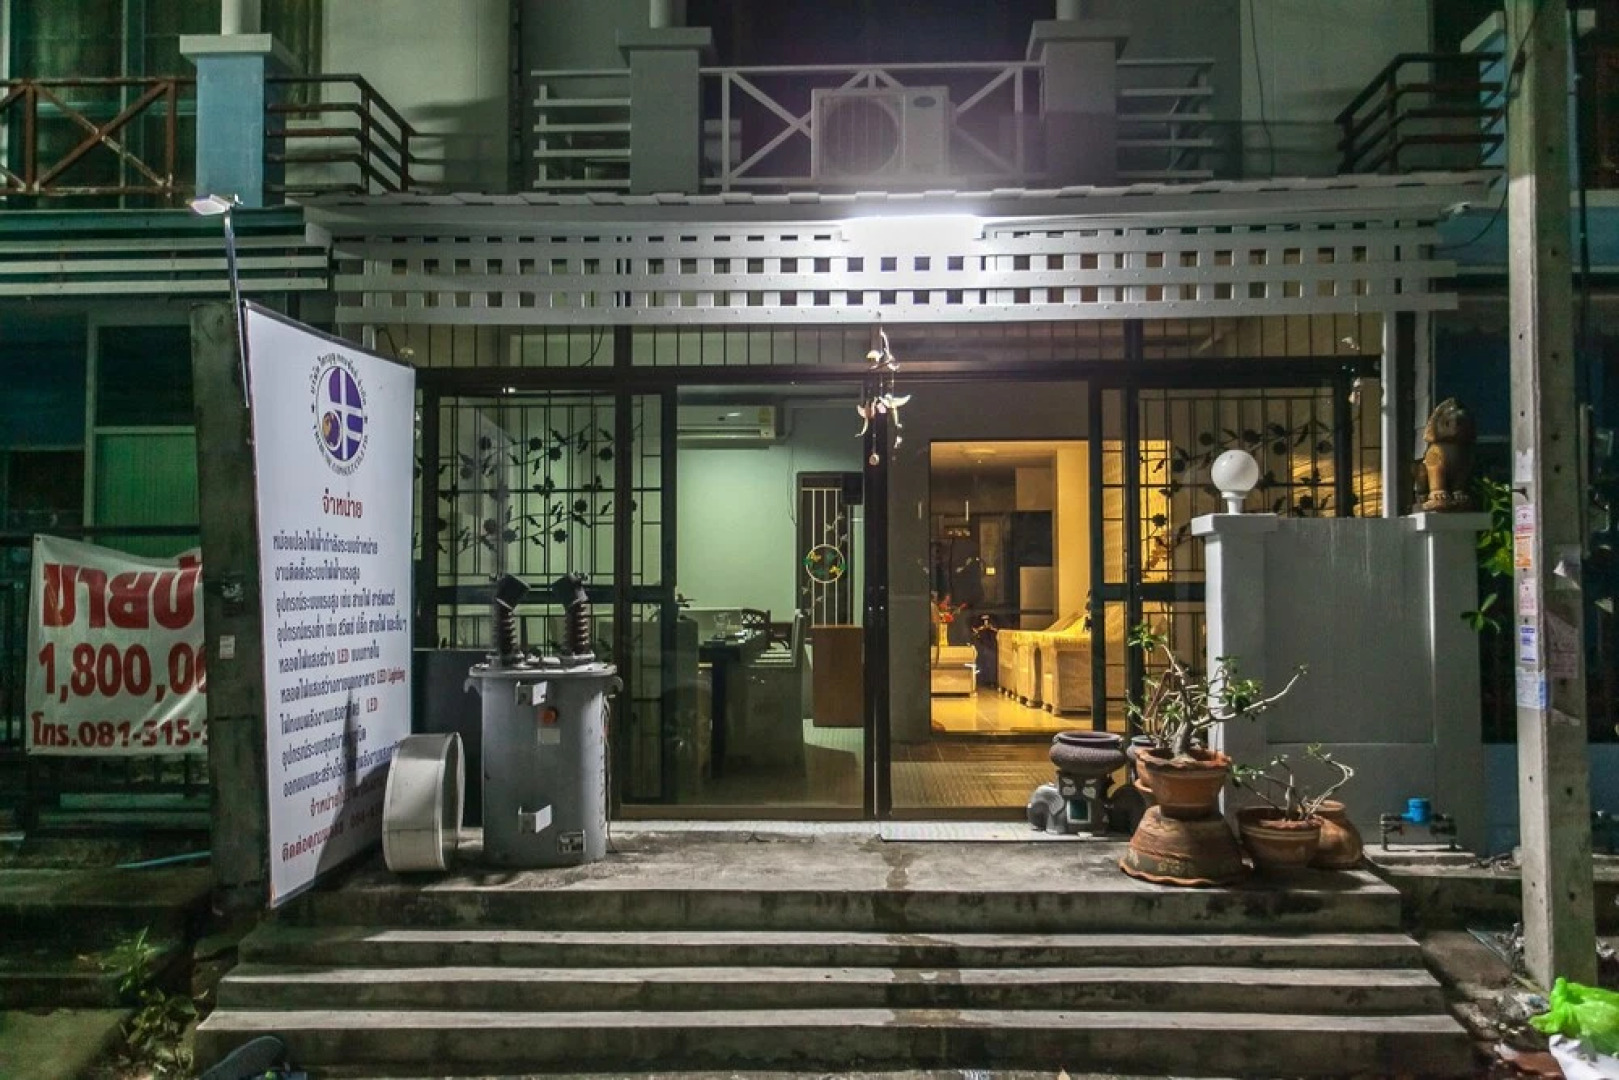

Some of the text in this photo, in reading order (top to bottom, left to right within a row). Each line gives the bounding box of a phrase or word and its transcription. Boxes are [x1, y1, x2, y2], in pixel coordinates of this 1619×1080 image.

[322, 487, 363, 519] จำหน่าย
[337, 648, 350, 665] LED
[377, 669, 387, 684] LED
[366, 697, 378, 713] LED
